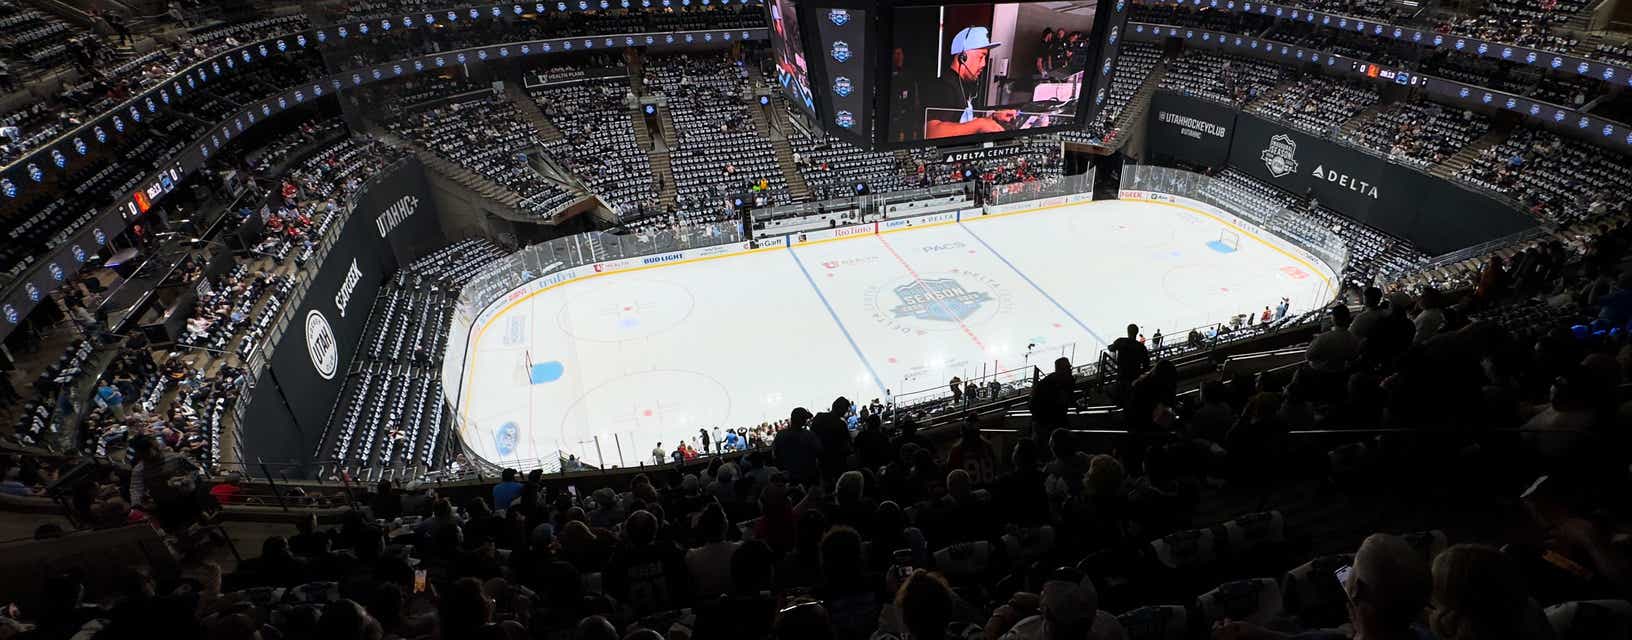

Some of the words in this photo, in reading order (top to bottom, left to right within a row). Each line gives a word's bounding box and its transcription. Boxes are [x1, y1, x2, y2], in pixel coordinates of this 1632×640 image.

[1360, 64, 1366, 73] 0
[1411, 76, 1418, 85] 0
[956, 151, 985, 161] DELTA
[988, 147, 1019, 157] CENTER
[128, 201, 138, 216] 0
[169, 168, 178, 181] 0
[1327, 170, 1378, 199] DELTA
[928, 214, 954, 223] DELTA
[644, 255, 661, 265] BUD
[661, 253, 684, 263] LIGHT
[906, 286, 965, 306] SEASON
[312, 326, 332, 365] UTAH
